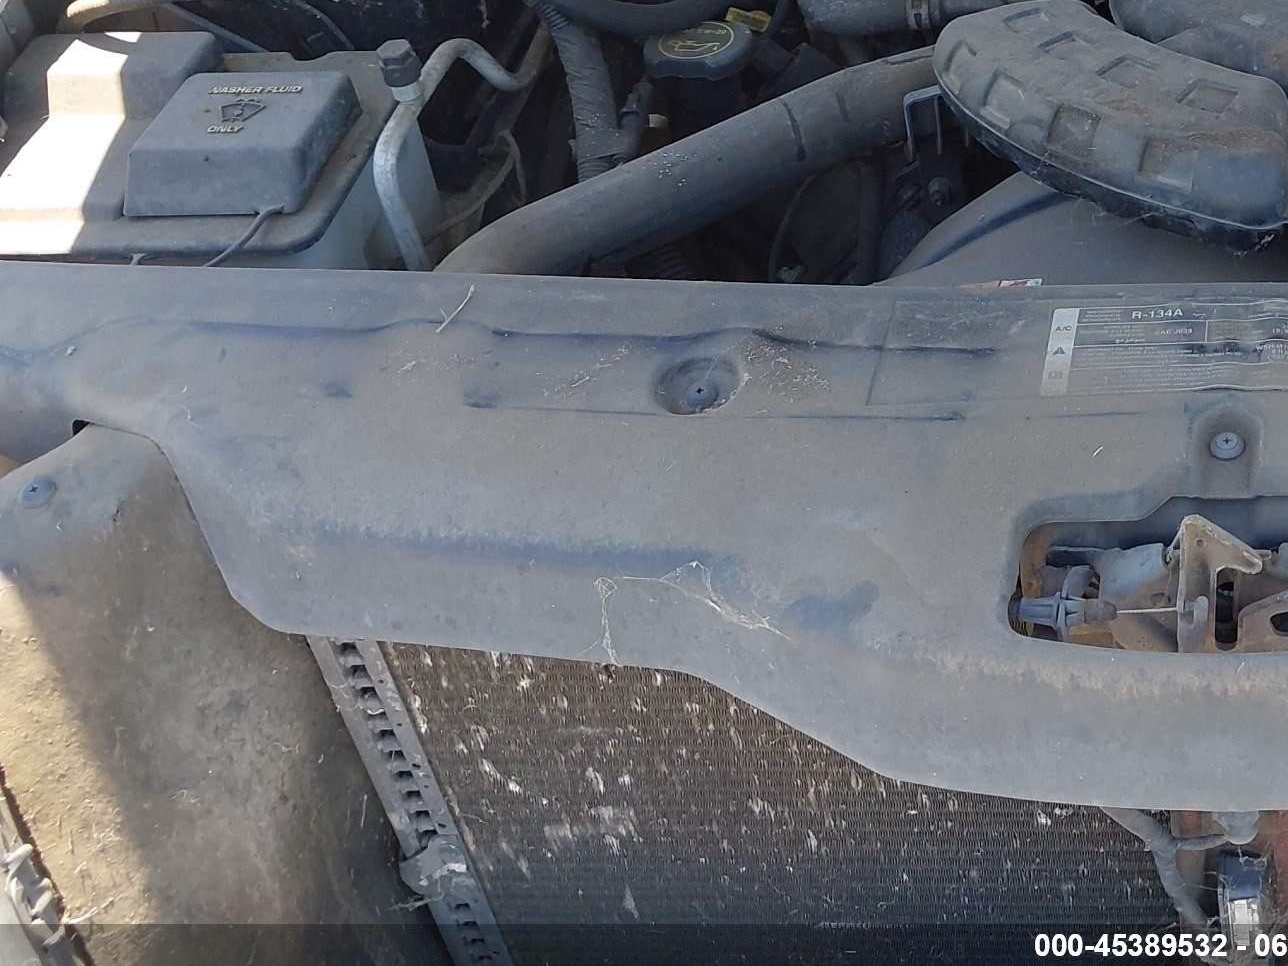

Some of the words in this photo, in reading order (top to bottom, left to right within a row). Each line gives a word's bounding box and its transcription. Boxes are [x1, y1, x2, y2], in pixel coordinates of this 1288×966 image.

[207, 85, 263, 95] WASHER
[264, 84, 302, 94] FLUID
[207, 123, 244, 133] ONLY
[1131, 308, 1184, 321] R-134A
